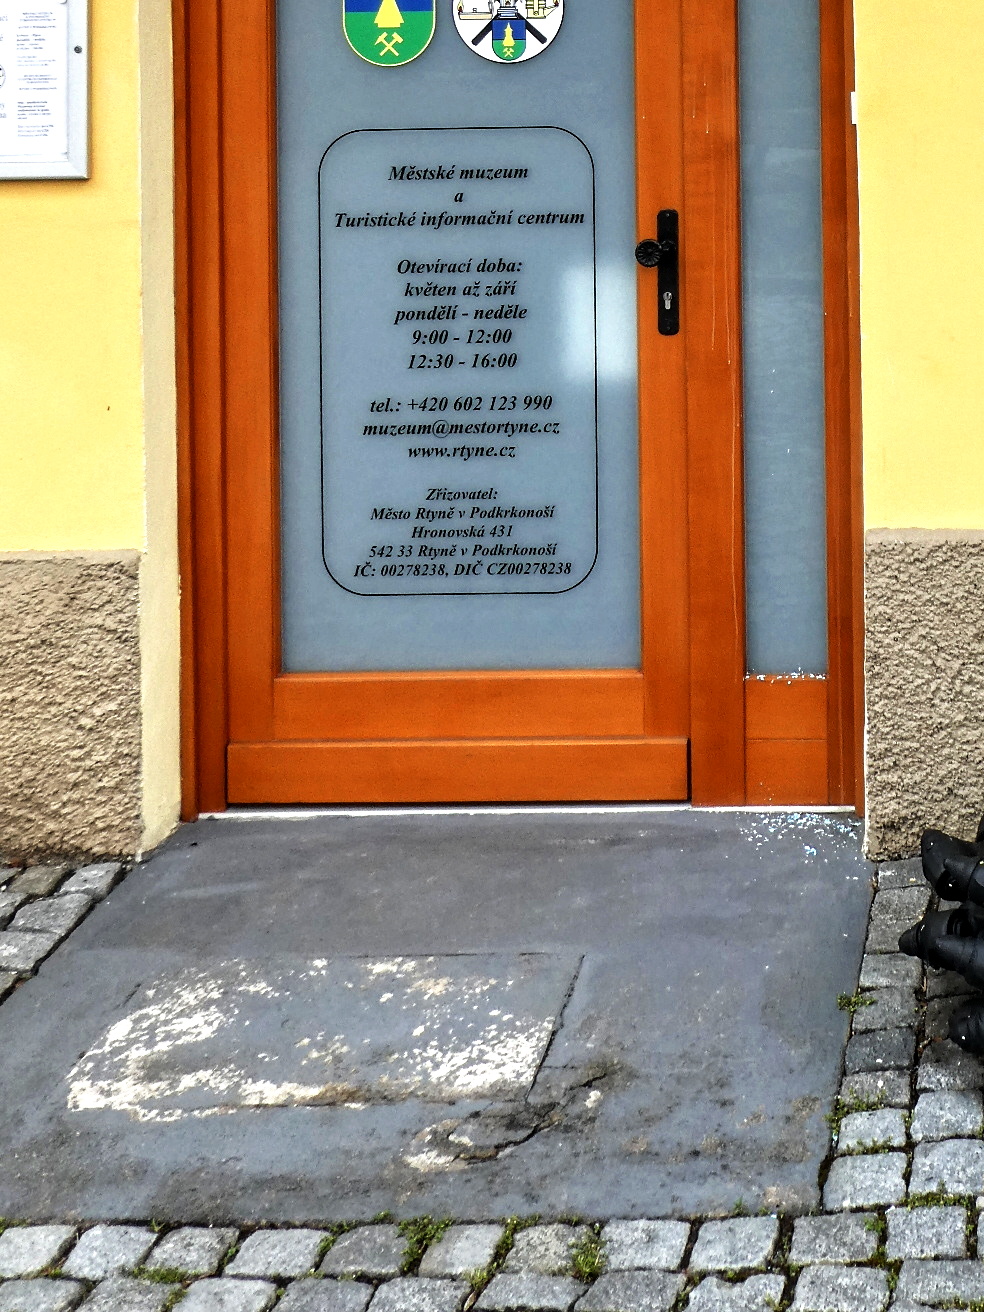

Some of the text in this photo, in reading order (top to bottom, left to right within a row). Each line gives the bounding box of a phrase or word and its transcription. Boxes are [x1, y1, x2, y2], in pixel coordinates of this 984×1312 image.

[387, 164, 529, 182] Městské muzeum
[453, 192, 464, 203] a
[334, 209, 586, 231] Turistické informační centrum
[396, 257, 523, 275] Otevírací doba:
[403, 279, 518, 298] květen až září
[392, 304, 459, 326] pondělí
[473, 303, 528, 320] neděle
[412, 329, 449, 345] 9:00
[466, 328, 513, 345] 12:00
[407, 353, 456, 370] 12:30
[471, 352, 519, 369] 16:00
[369, 394, 553, 413] tel.: +420 602 123 990
[362, 419, 561, 439] muzeum@mestortyne.cz
[407, 444, 516, 462] www.rtyne.cz
[425, 487, 499, 502] Zřizovatel:
[369, 504, 556, 523] Město Rtyně v Podkrkonoší
[411, 524, 514, 539] Hronovská 431
[368, 542, 558, 560] 542 33 Rtyně v Podkrkonoší
[353, 559, 572, 578] IČ: 00278238, DIČ CZ00278238
